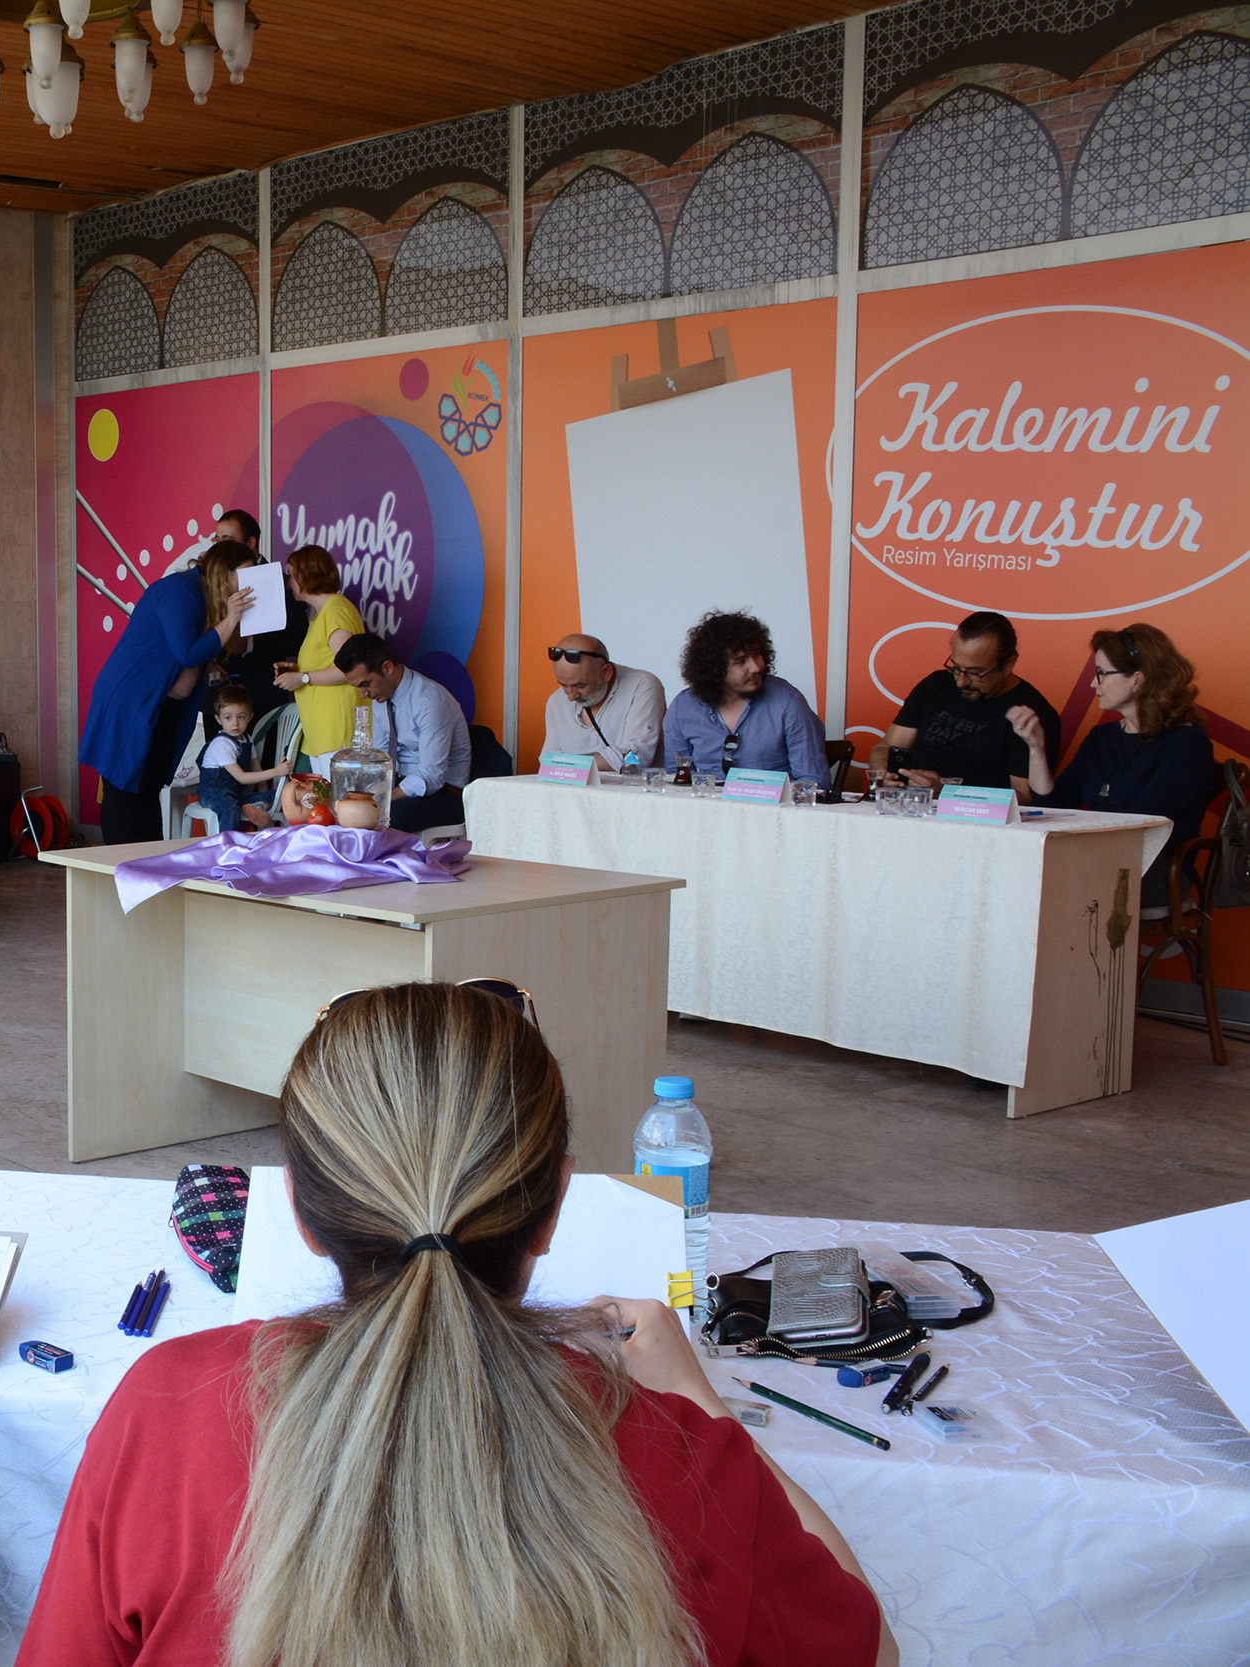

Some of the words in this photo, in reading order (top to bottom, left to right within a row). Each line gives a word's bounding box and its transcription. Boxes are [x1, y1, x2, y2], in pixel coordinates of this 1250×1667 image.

[468, 391, 490, 402] KOMEK
[879, 374, 1231, 453] Kalemini
[277, 491, 400, 561] Yumak
[855, 471, 1203, 567] Konuştur
[882, 545, 936, 566] Resim
[943, 547, 1032, 571] Yarışması
